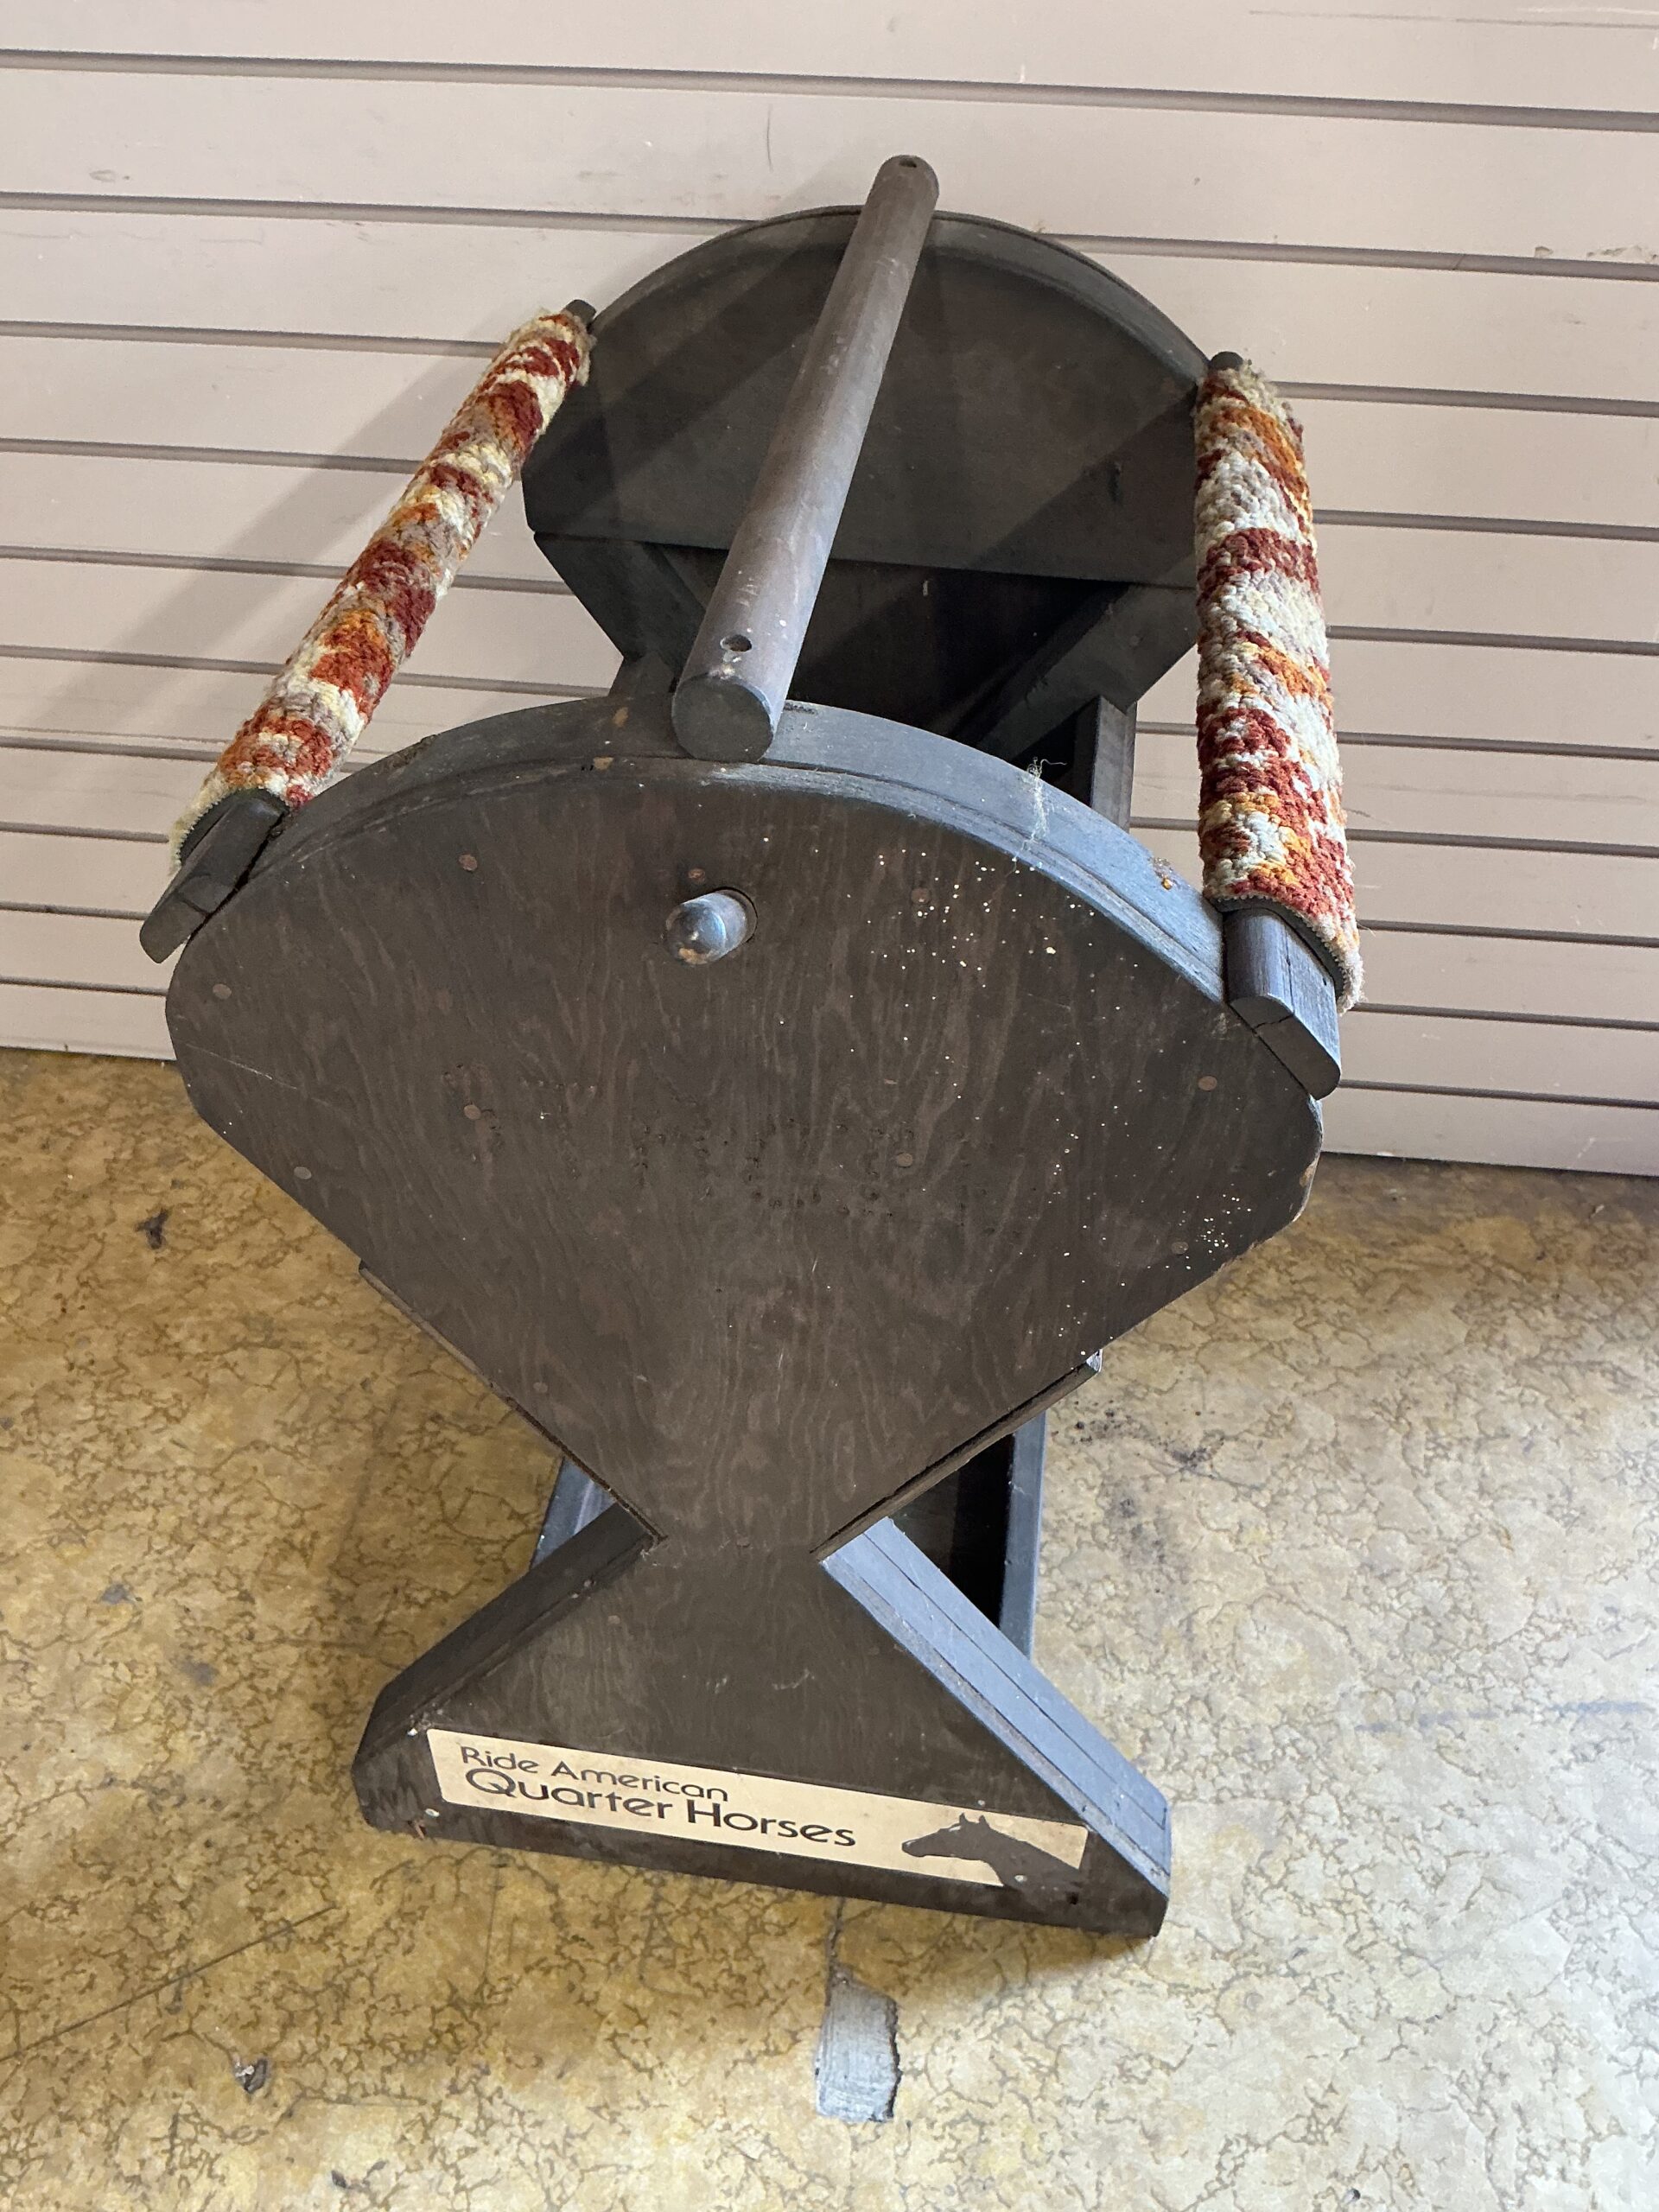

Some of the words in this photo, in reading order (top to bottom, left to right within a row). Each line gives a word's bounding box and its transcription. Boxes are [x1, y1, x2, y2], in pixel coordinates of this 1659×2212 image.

[461, 1745, 539, 1774] Ride
[550, 1761, 728, 1802] American
[465, 1768, 673, 1819] Quarter
[688, 1799, 856, 1847] Horses
